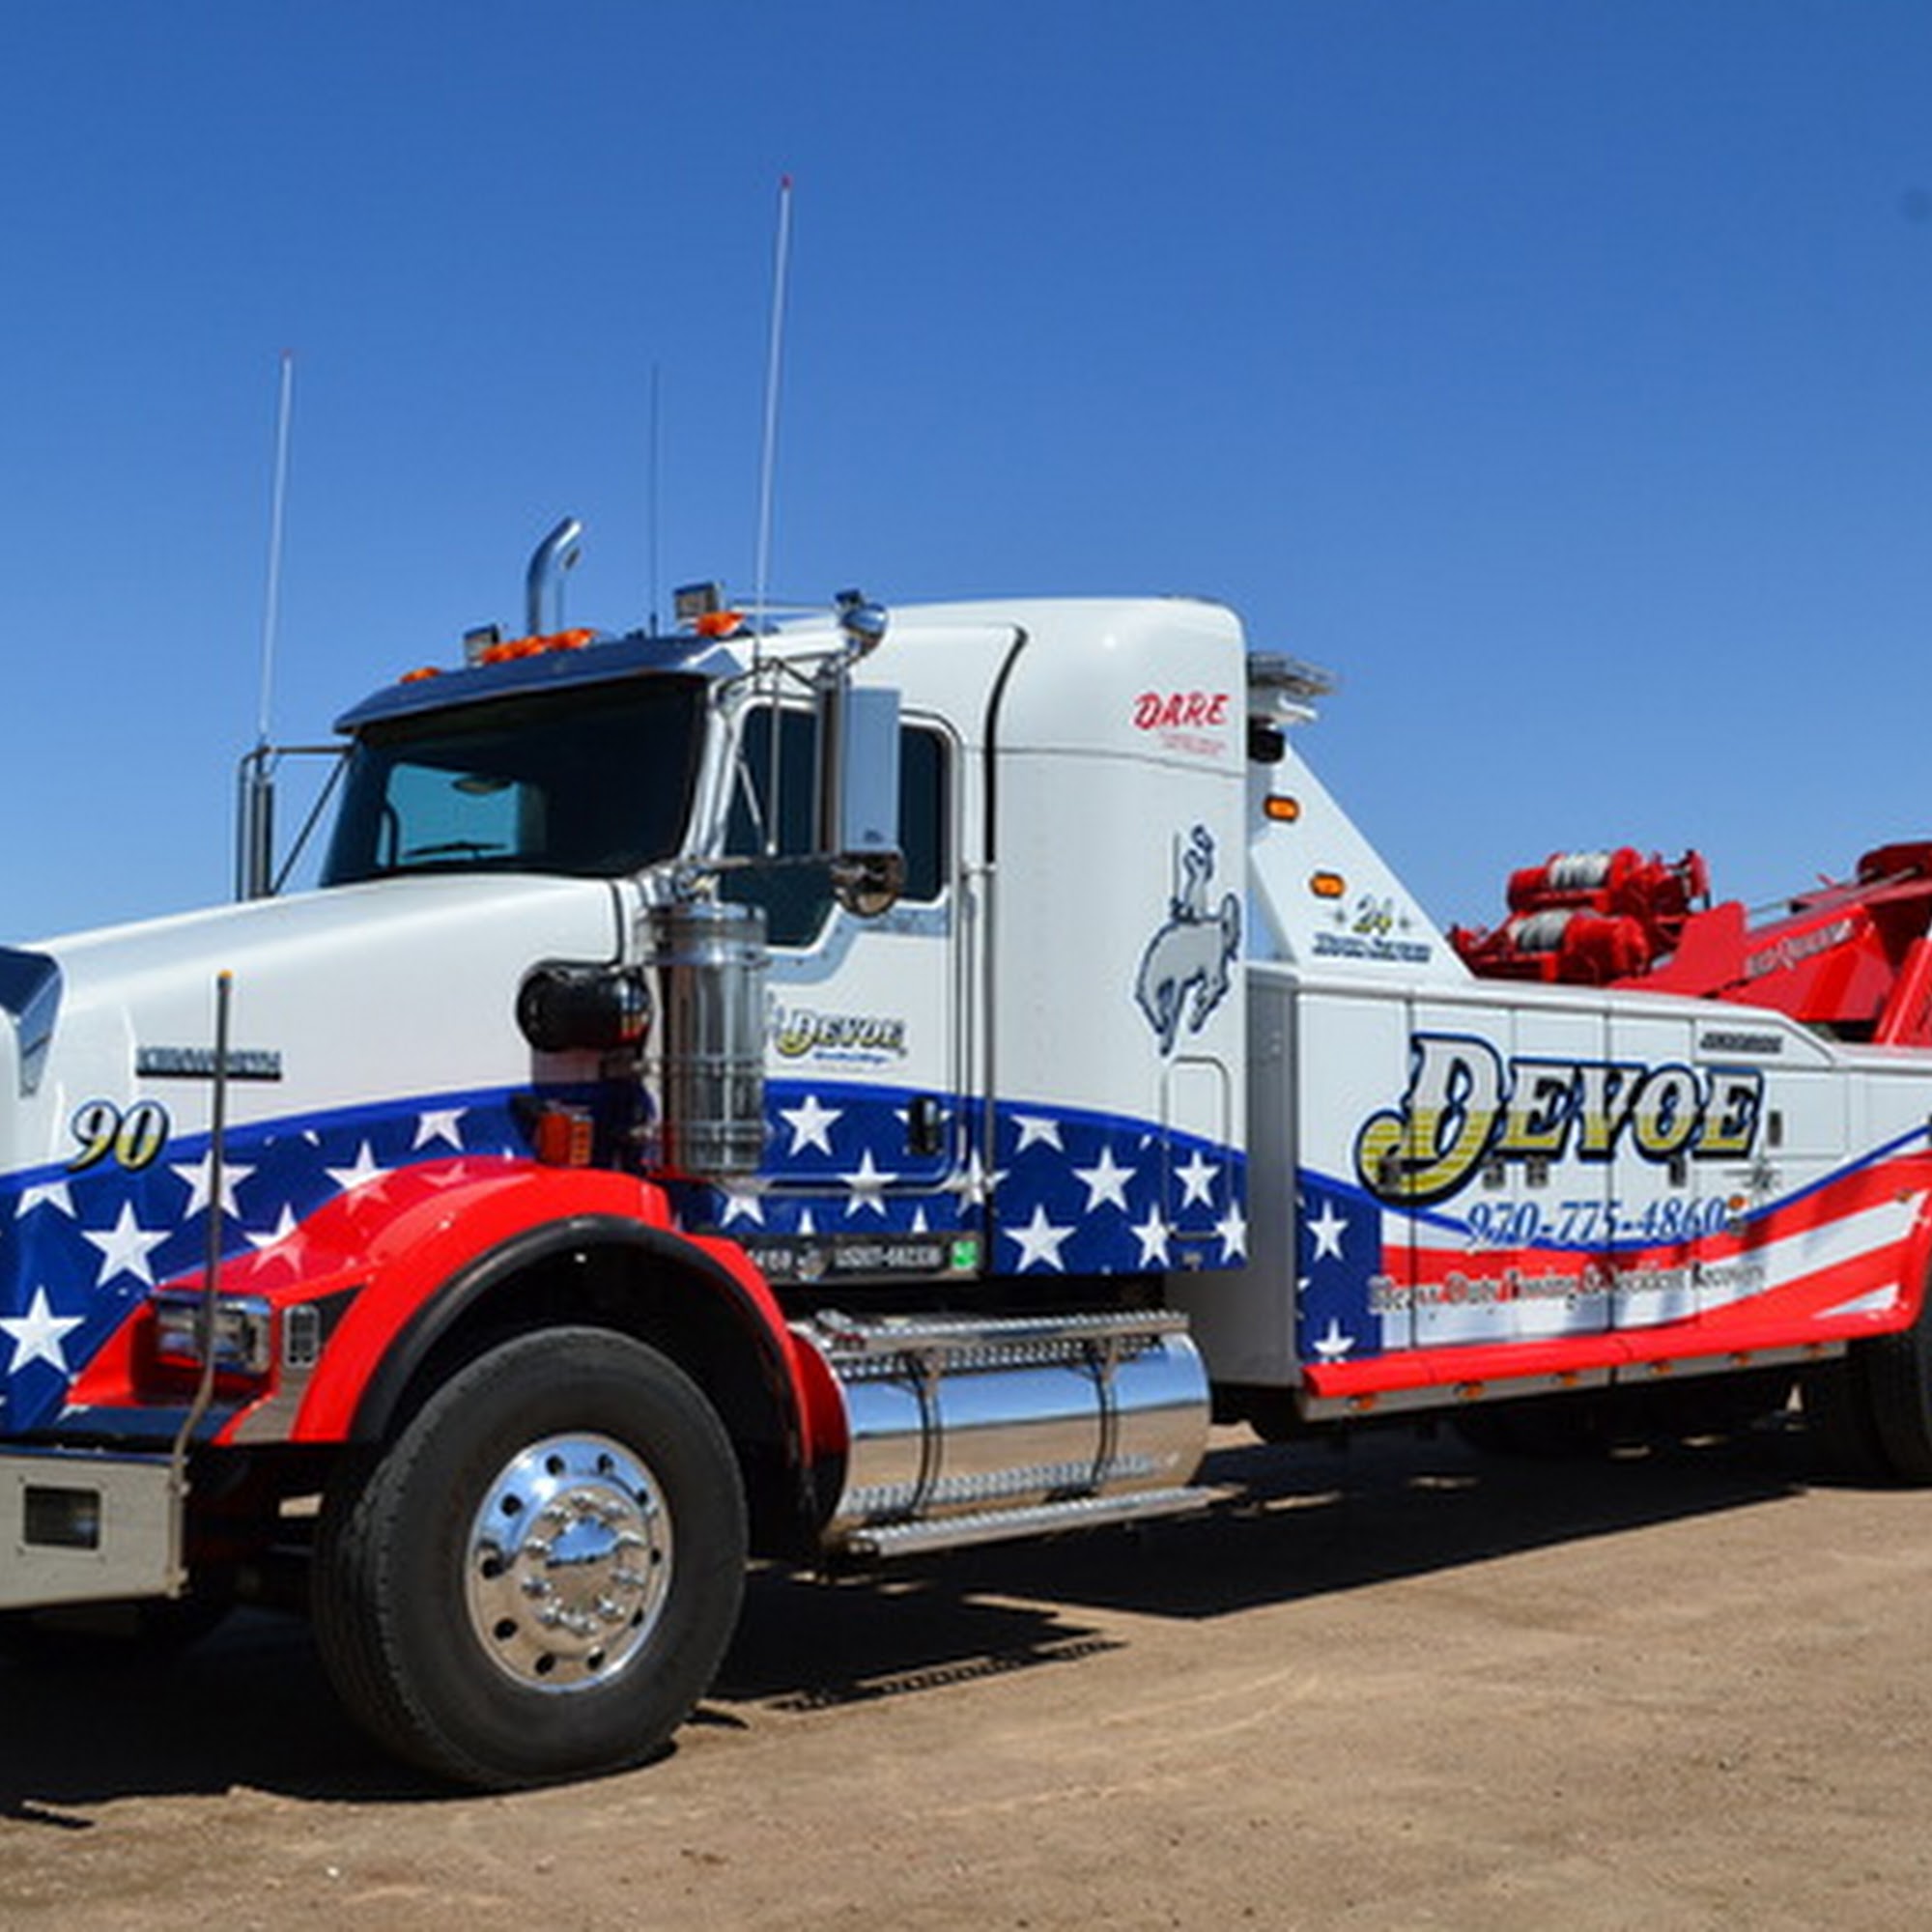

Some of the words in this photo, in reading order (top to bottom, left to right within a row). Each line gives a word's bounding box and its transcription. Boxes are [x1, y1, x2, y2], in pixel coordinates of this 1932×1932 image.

[1132, 691, 1229, 730] DARE
[66, 1099, 170, 1173] 90
[1354, 1032, 1764, 1208] DEVOE
[1465, 1197, 1728, 1246] 970-775-4860
